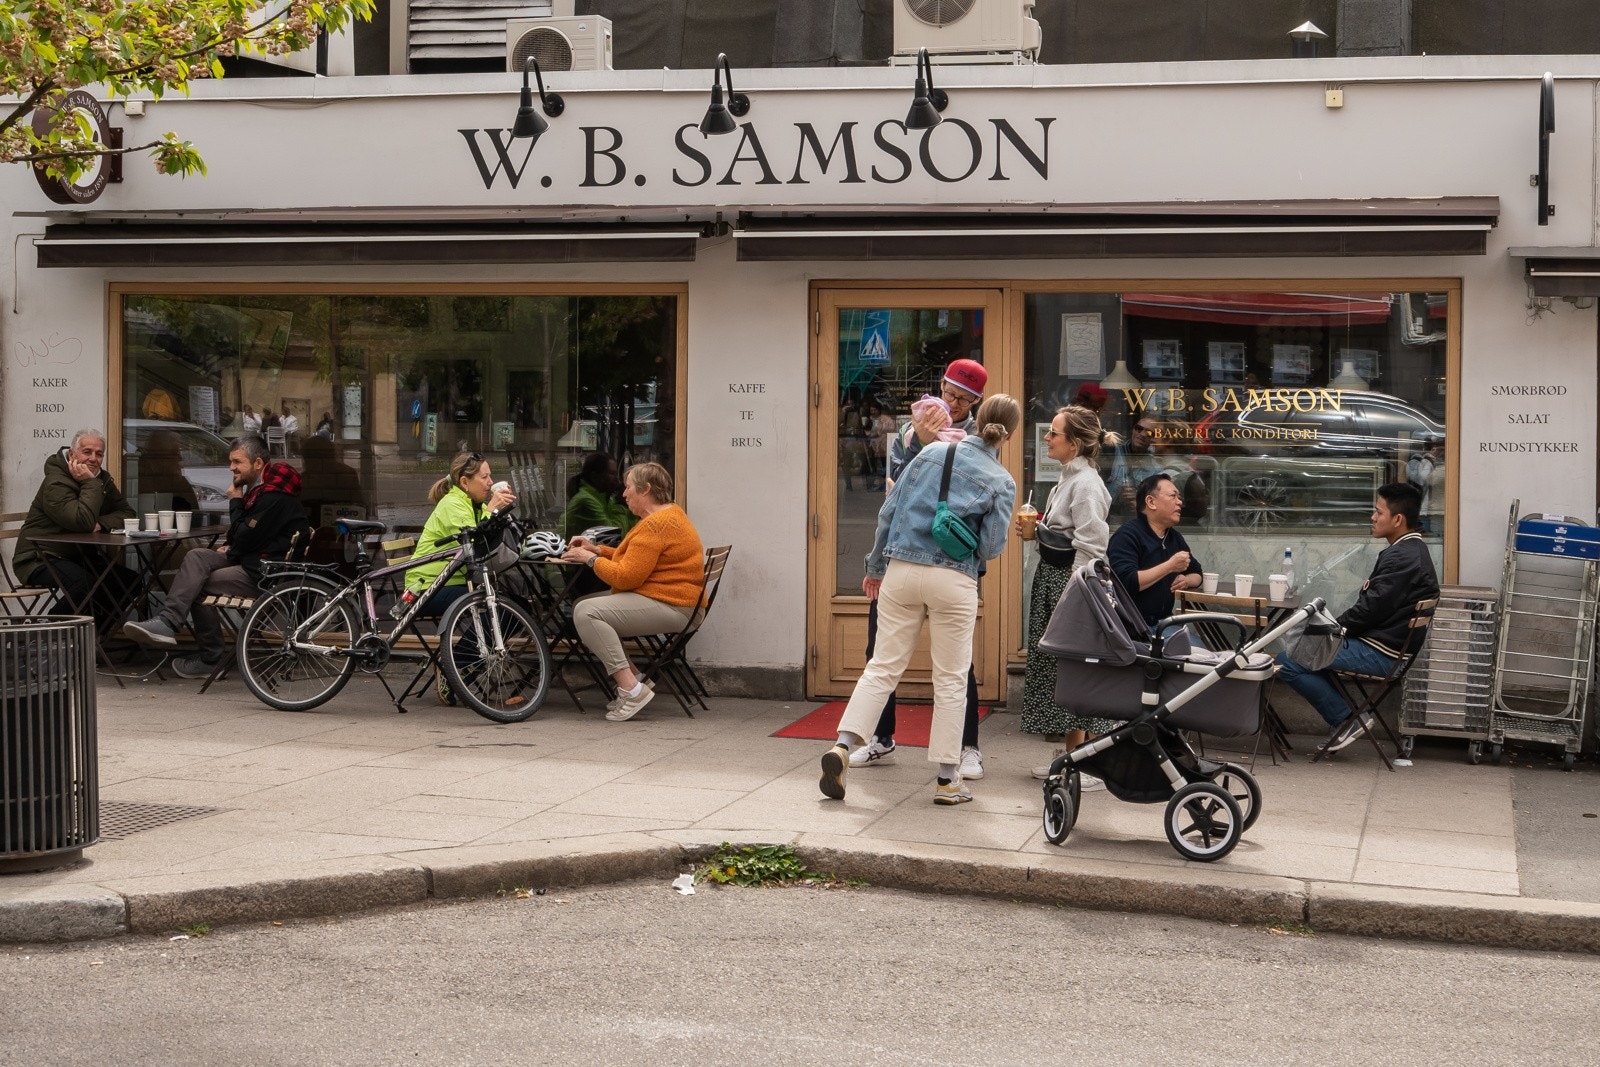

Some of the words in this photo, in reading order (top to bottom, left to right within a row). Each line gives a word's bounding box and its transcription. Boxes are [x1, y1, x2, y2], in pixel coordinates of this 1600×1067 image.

[76, 95, 104, 124] SAMSON
[457, 128, 552, 190] W.
[578, 126, 647, 188] B.
[672, 117, 1057, 187] SAMSON
[32, 378, 68, 388] KAKER
[728, 383, 766, 393] KAFFE
[1491, 385, 1567, 396] SMØRBRØD
[1121, 388, 1158, 412] W.
[1168, 388, 1194, 412] B.
[1201, 387, 1343, 413] SAMSON
[35, 403, 65, 413] BRØD
[739, 410, 755, 420] TE
[1507, 414, 1551, 424] SALAT
[33, 429, 67, 438] BAKST
[1154, 428, 1210, 439] BAKERI
[1215, 428, 1226, 439] &
[1231, 428, 1319, 440] KONDITORI
[731, 437, 762, 447] BRUS
[1479, 442, 1579, 453] RUNDSTYKKER
[336, 507, 359, 518] alpro
